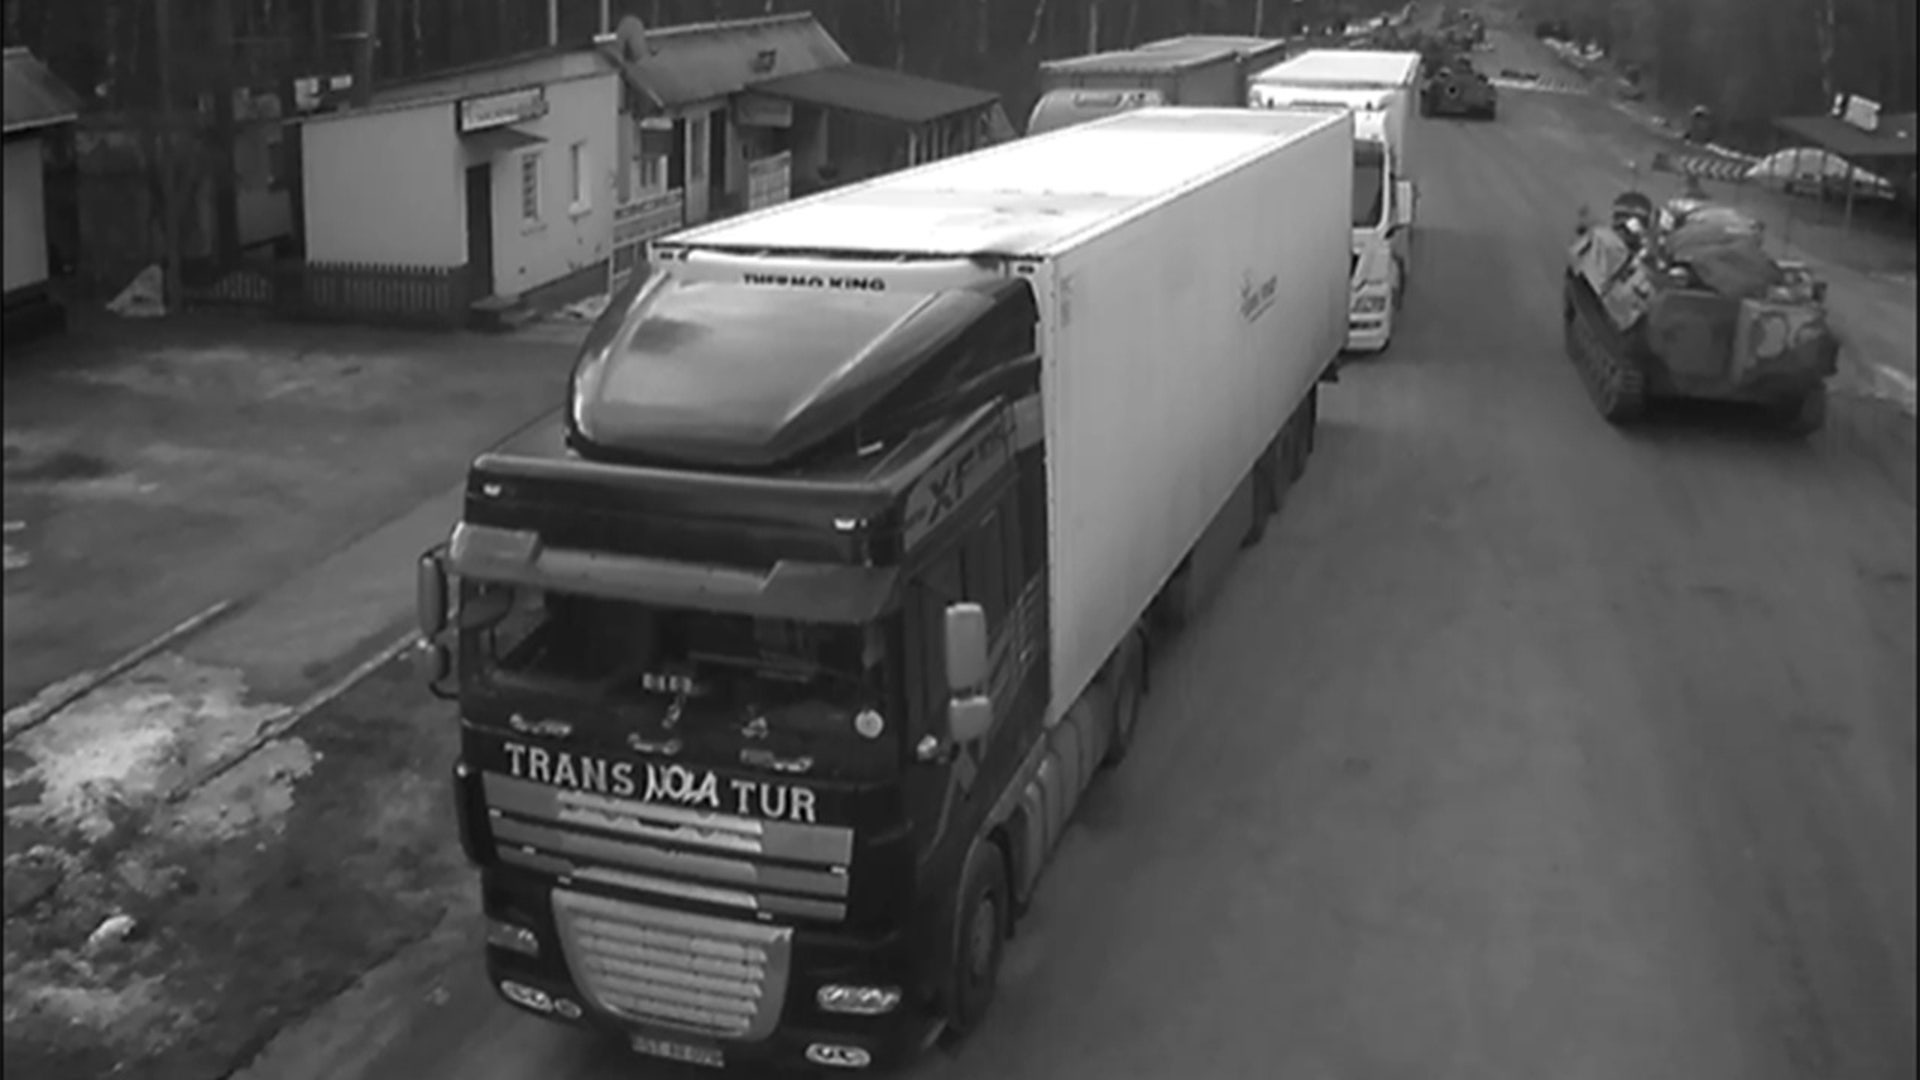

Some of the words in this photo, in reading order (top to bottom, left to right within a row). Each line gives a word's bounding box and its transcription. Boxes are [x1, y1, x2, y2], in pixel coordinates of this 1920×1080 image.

[743, 273, 823, 288] THERMO
[829, 276, 886, 292] KING
[504, 742, 635, 796] TRANS
[731, 780, 817, 823] TUR
